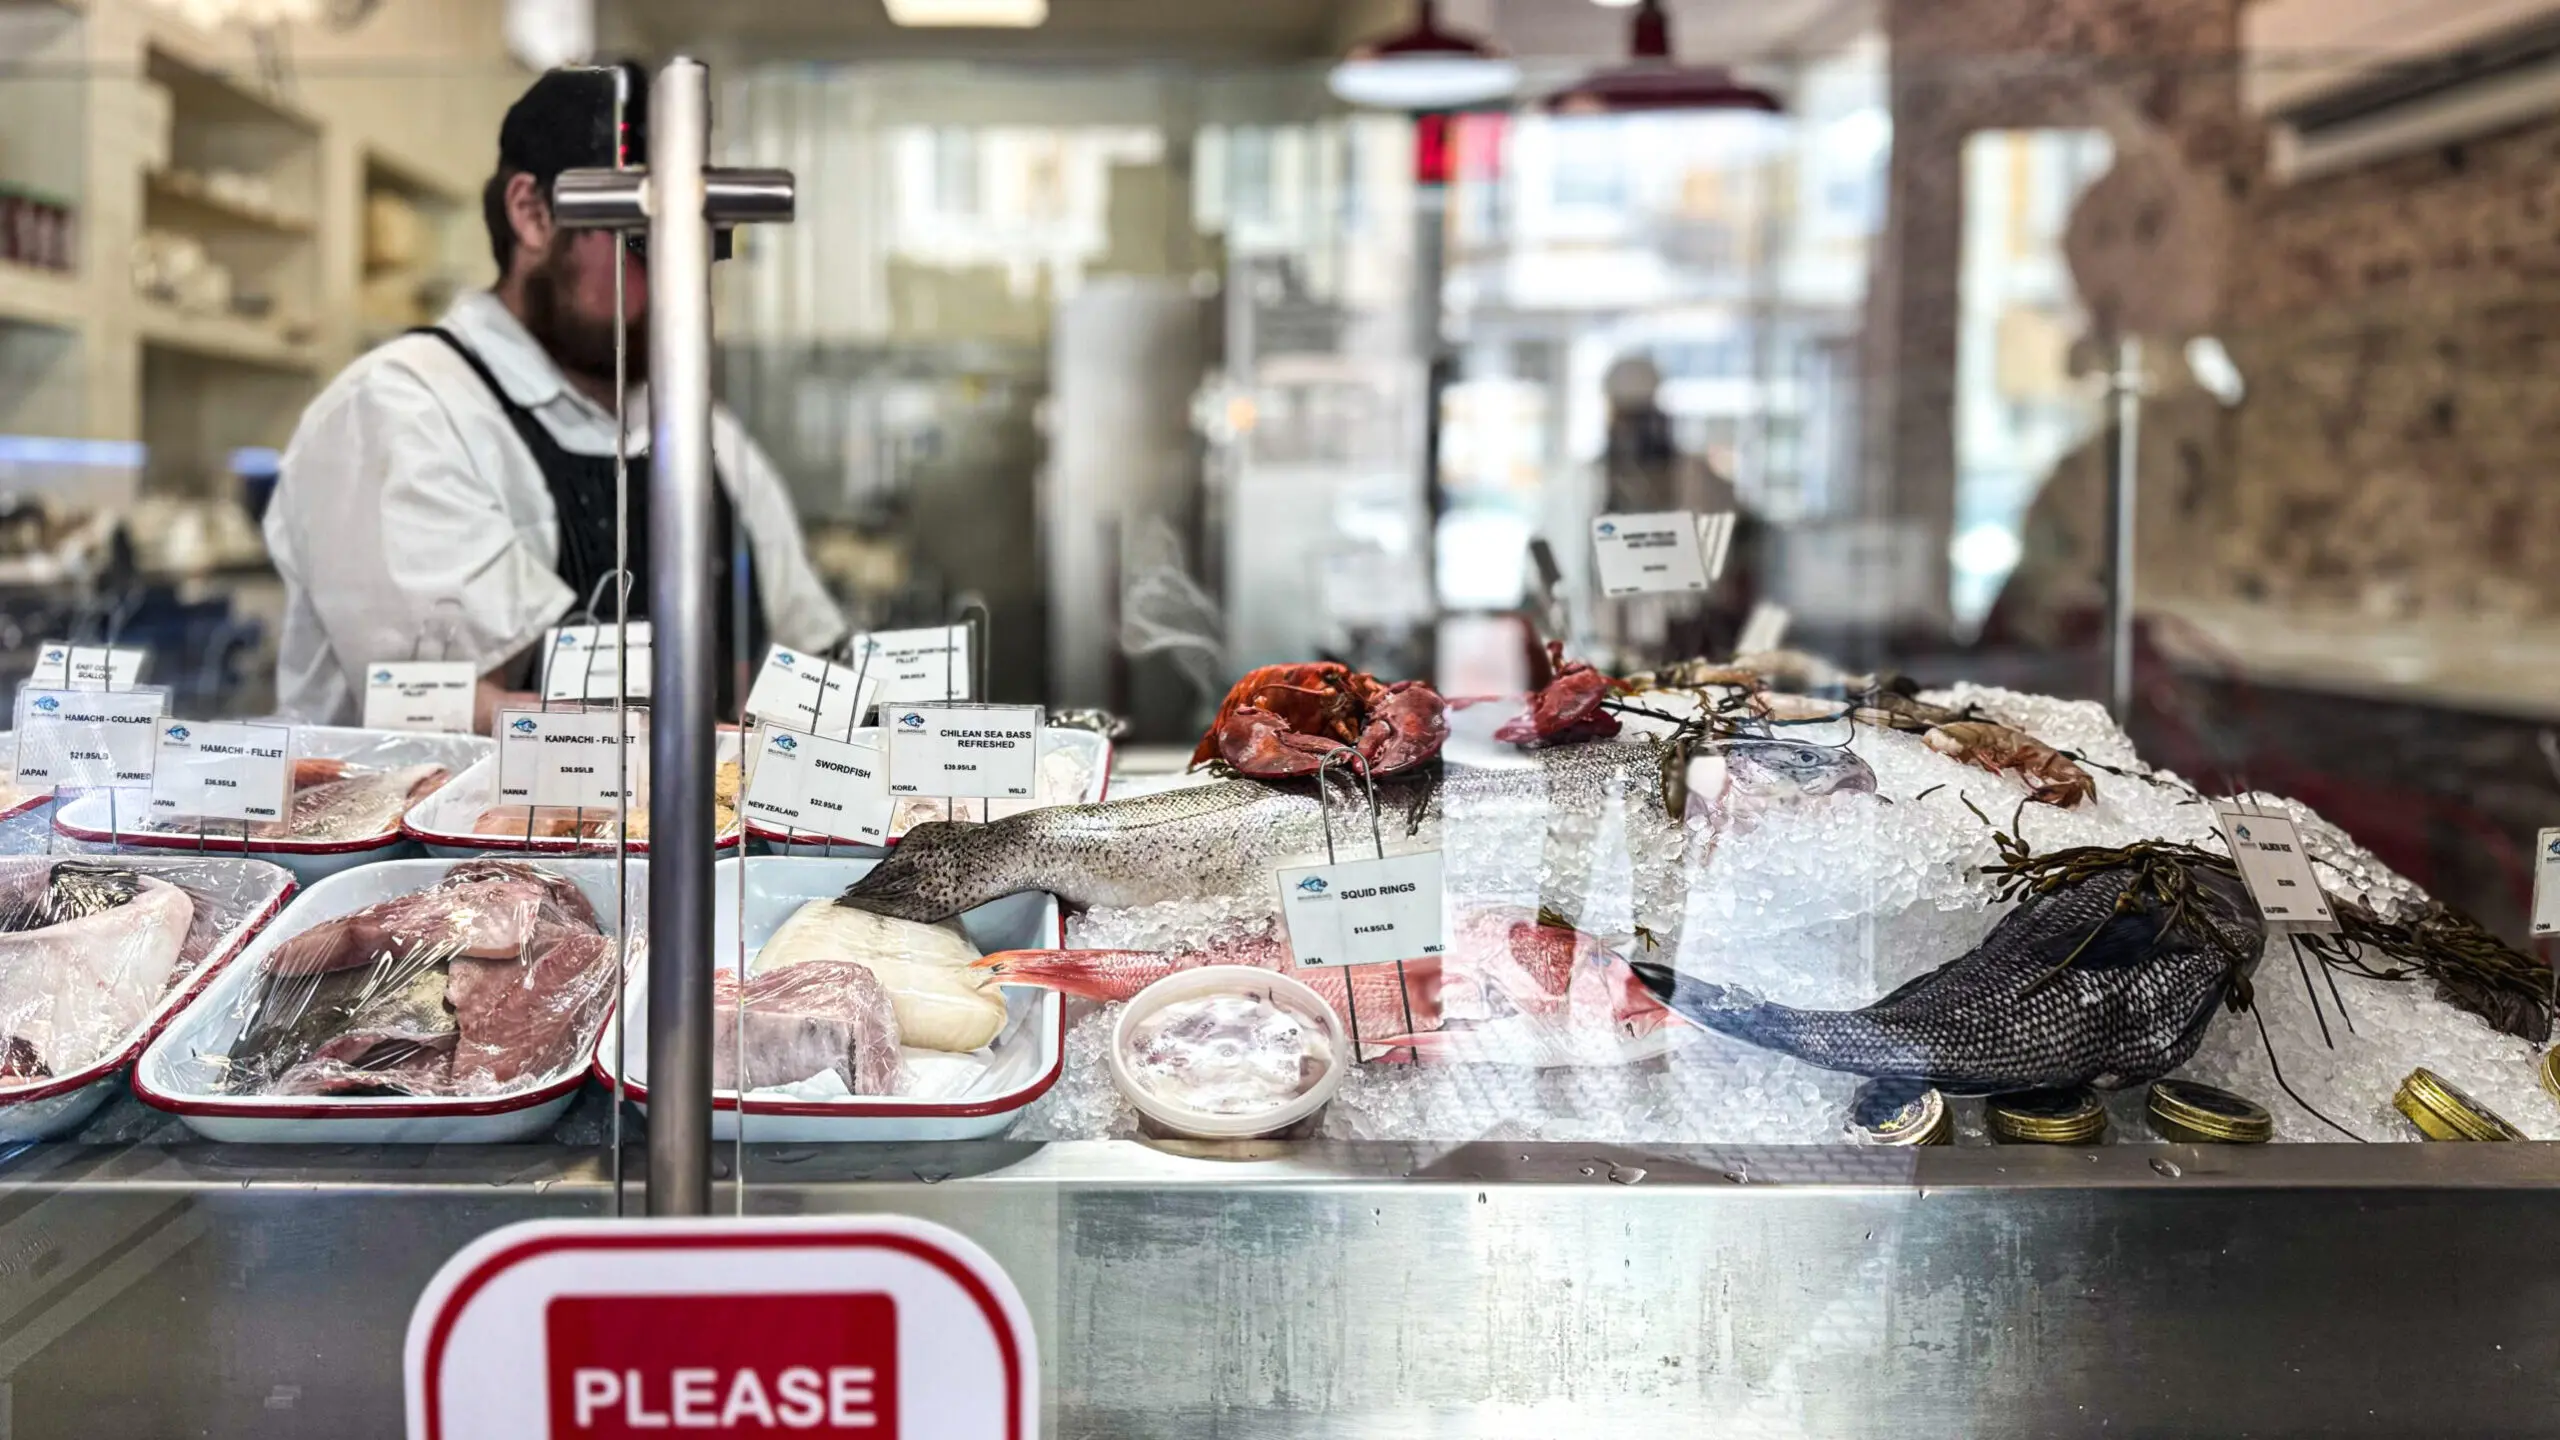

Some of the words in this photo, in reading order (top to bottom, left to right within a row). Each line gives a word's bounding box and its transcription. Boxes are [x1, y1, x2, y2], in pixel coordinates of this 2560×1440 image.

[94, 664, 117, 673] COST
[65, 714, 104, 722] HAMACHI
[111, 715, 152, 724] COLLARS
[940, 729, 982, 738] CHILEAN
[984, 730, 1002, 739] SEA
[1005, 731, 1032, 739] BASS
[545, 735, 594, 744] KANPACHI
[957, 740, 1015, 749] REFRESHED
[70, 751, 109, 761] $21.95/LB
[200, 744, 244, 755] HAMACHI
[251, 748, 283, 758] FILLET
[20, 769, 48, 777] JAPAN
[814, 759, 871, 779] SWORDFISH
[116, 772, 152, 780] FARMED
[152, 799, 176, 807] JAPAN
[245, 807, 276, 816] FARMED
[748, 800, 764, 809] NEW
[765, 804, 799, 818] ZEALAND
[861, 826, 880, 836] WILD
[1341, 889, 1377, 900] SQUID
[1379, 883, 1416, 895] RINGS
[1354, 924, 1394, 934] $14.95/LB
[1423, 944, 1446, 953] WILD
[573, 1367, 876, 1427] PLEASE
